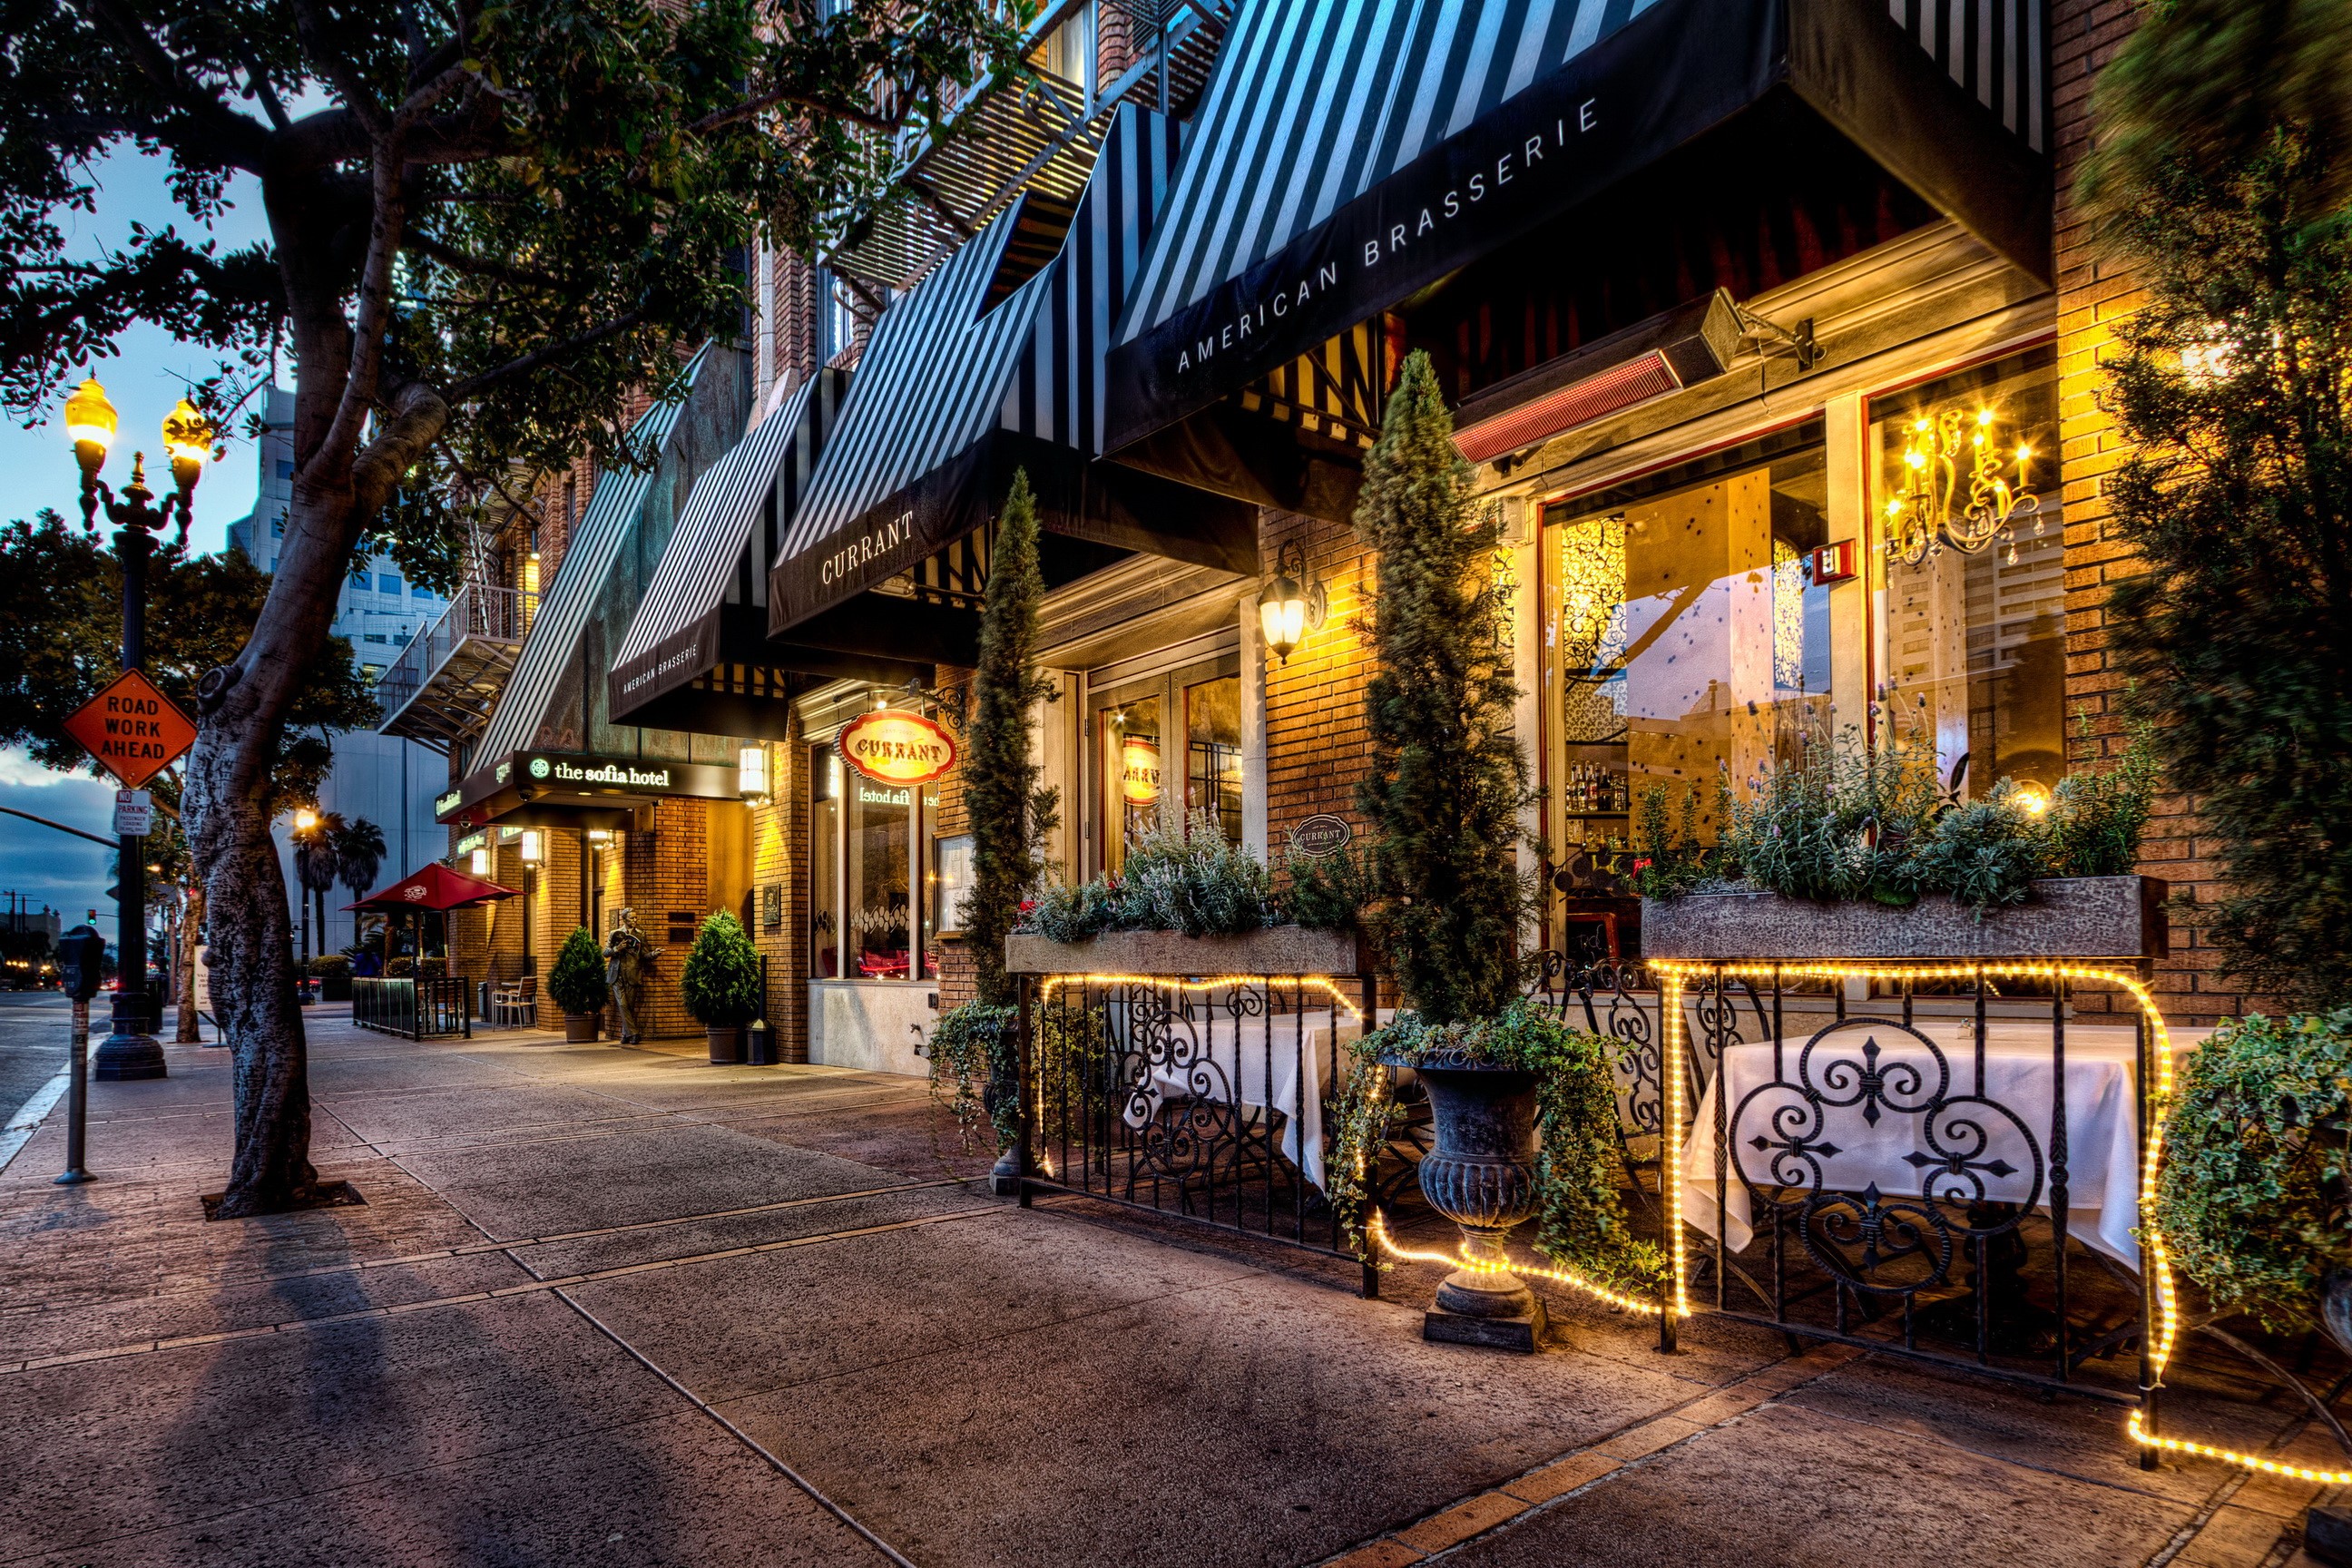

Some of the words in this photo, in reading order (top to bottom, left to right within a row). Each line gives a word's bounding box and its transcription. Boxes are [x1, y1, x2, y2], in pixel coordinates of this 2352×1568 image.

[1178, 261, 1337, 374] AMERICAN
[1365, 98, 1598, 268] BRASSERIE
[822, 510, 913, 585] CURRANT
[623, 668, 655, 694] AMERICAN
[658, 643, 697, 675] BRASSERIE
[107, 696, 159, 716] ROAD
[104, 718, 161, 738] WORK
[101, 740, 165, 760] AHEAD
[855, 739, 942, 762] CURRANT
[554, 762, 583, 779] the
[585, 765, 629, 783] sofia
[629, 768, 670, 786] hotel
[119, 791, 131, 801] NO
[118, 805, 148, 814] PARKING
[1299, 829, 1340, 841] CURRANT
